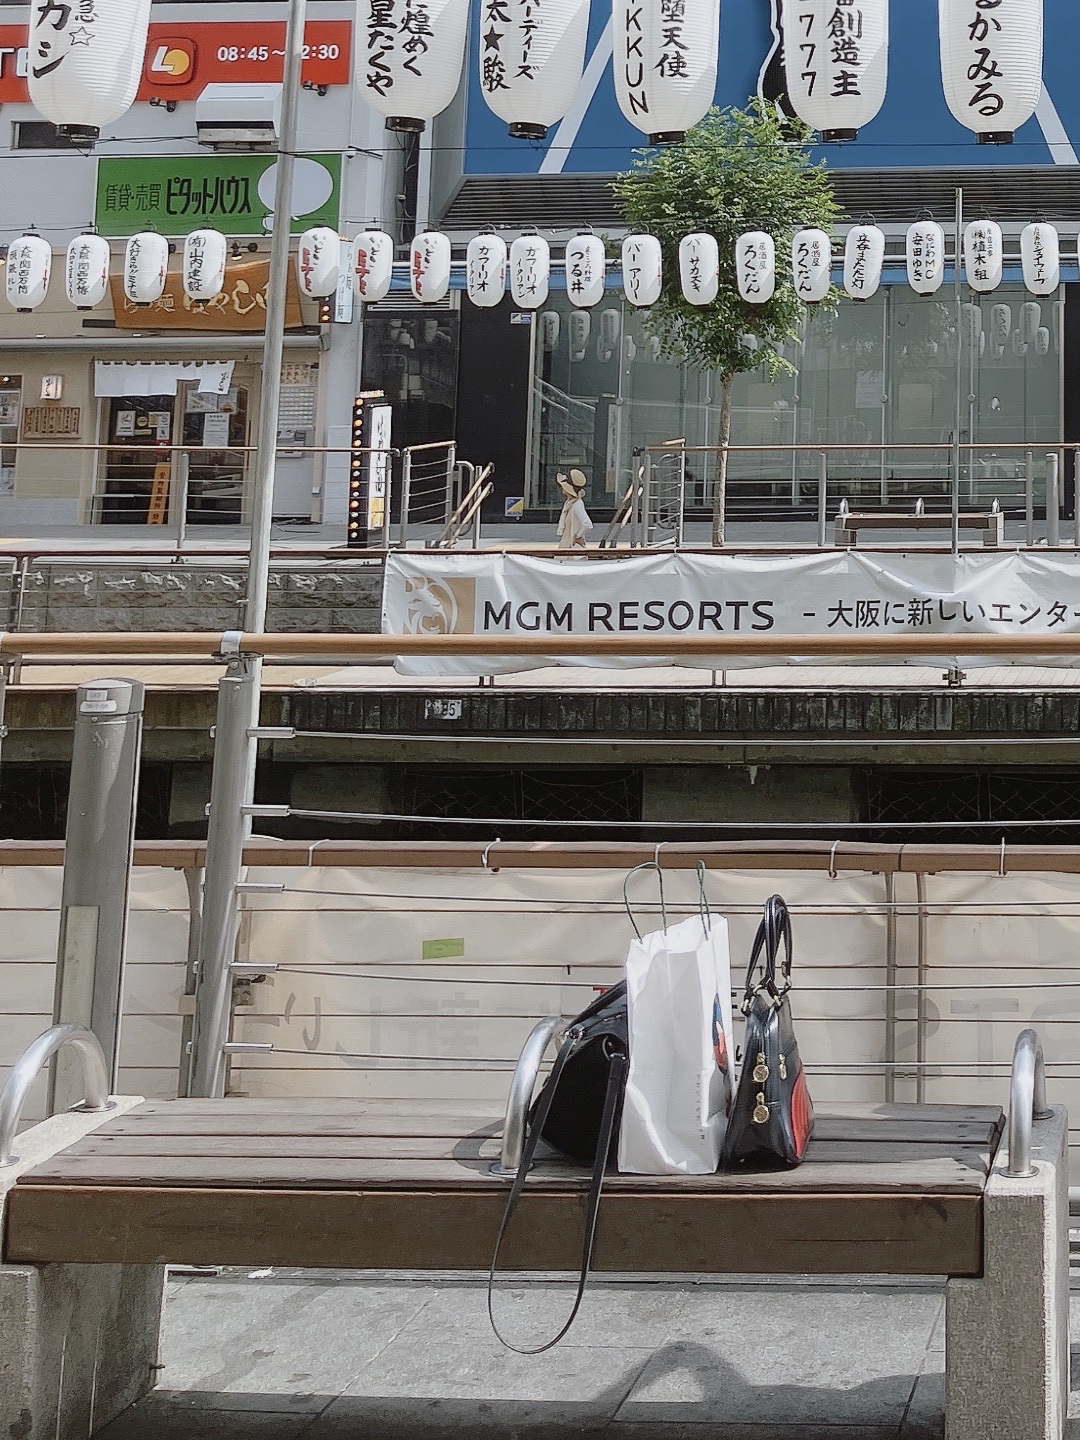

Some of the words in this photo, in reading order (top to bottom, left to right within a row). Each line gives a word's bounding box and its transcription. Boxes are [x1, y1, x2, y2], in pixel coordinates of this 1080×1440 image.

[165, 176, 252, 216] ピタットハウス
[483, 600, 573, 632] MGM
[587, 600, 775, 633] RESORTS
